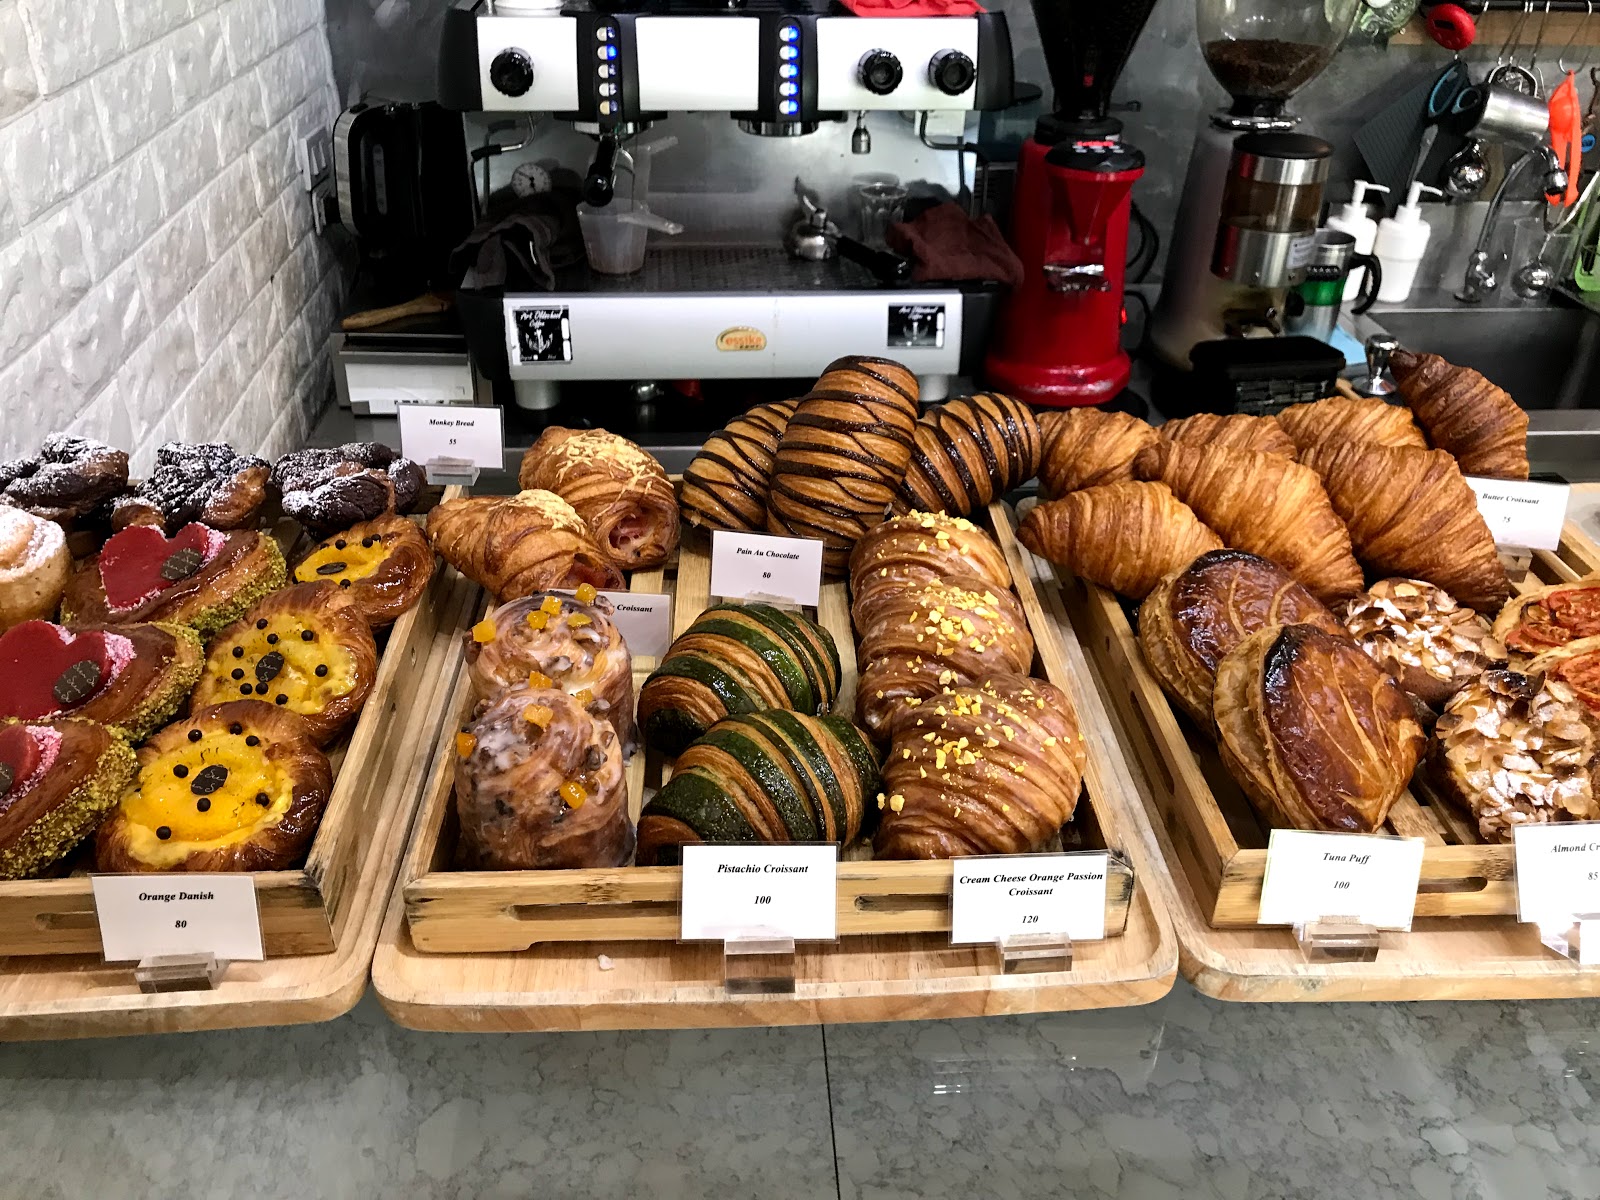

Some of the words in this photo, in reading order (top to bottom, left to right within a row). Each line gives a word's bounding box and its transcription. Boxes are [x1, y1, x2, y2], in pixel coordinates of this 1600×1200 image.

[429, 419, 454, 427] Monkey
[1482, 493, 1504, 501] Butter
[1506, 495, 1539, 504] Croissant
[736, 547, 752, 555] Pain
[766, 550, 800, 560] Chocolate
[617, 604, 653, 612] Croissant
[1550, 843, 1586, 853] Almond
[1323, 852, 1346, 861] Tuna
[1349, 854, 1371, 865] Puff
[717, 864, 761, 873] Pistachio
[764, 864, 809, 873] Croissant
[959, 875, 990, 884] Cream
[993, 874, 1027, 883] Cheese
[1029, 873, 1065, 883] Orange
[1067, 872, 1103, 881] Passion
[1588, 871, 1599, 880] 85
[1333, 881, 1350, 889] 100
[1008, 887, 1054, 896] Croissant
[138, 892, 176, 903] Orange
[179, 891, 214, 900] Danish
[754, 895, 772, 905] 100
[174, 919, 188, 928] 80
[1022, 915, 1039, 924] 120
